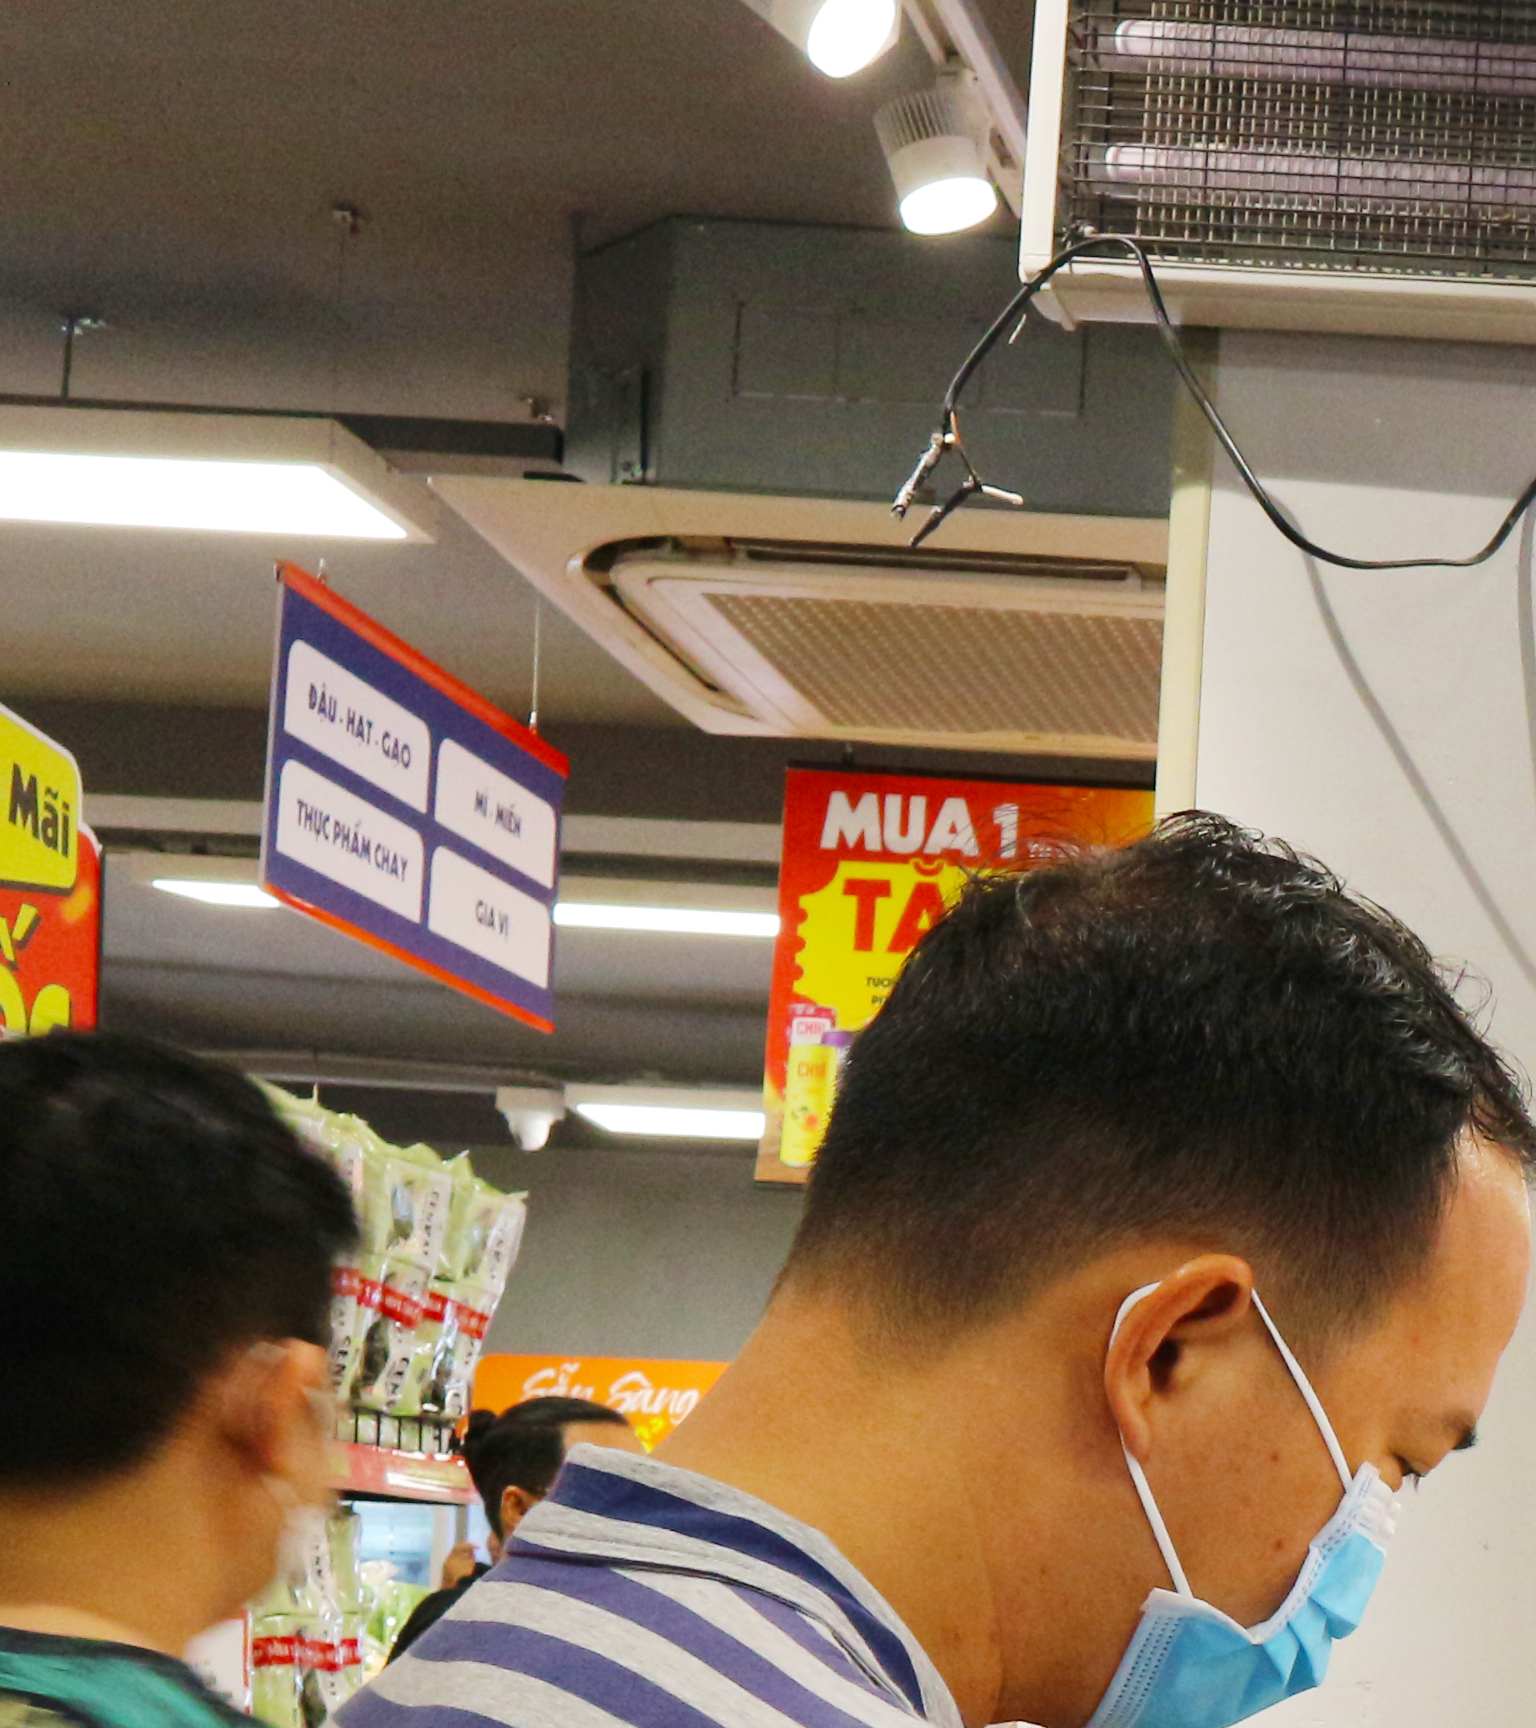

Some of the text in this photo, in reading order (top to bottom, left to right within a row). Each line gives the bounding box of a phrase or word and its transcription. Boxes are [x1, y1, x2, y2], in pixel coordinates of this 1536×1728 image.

[8, 762, 70, 858] Mãi
[296, 798, 408, 882] THỰC PHẨM CHAY
[820, 790, 1019, 859] MUA 1
[475, 899, 496, 931] GIA
